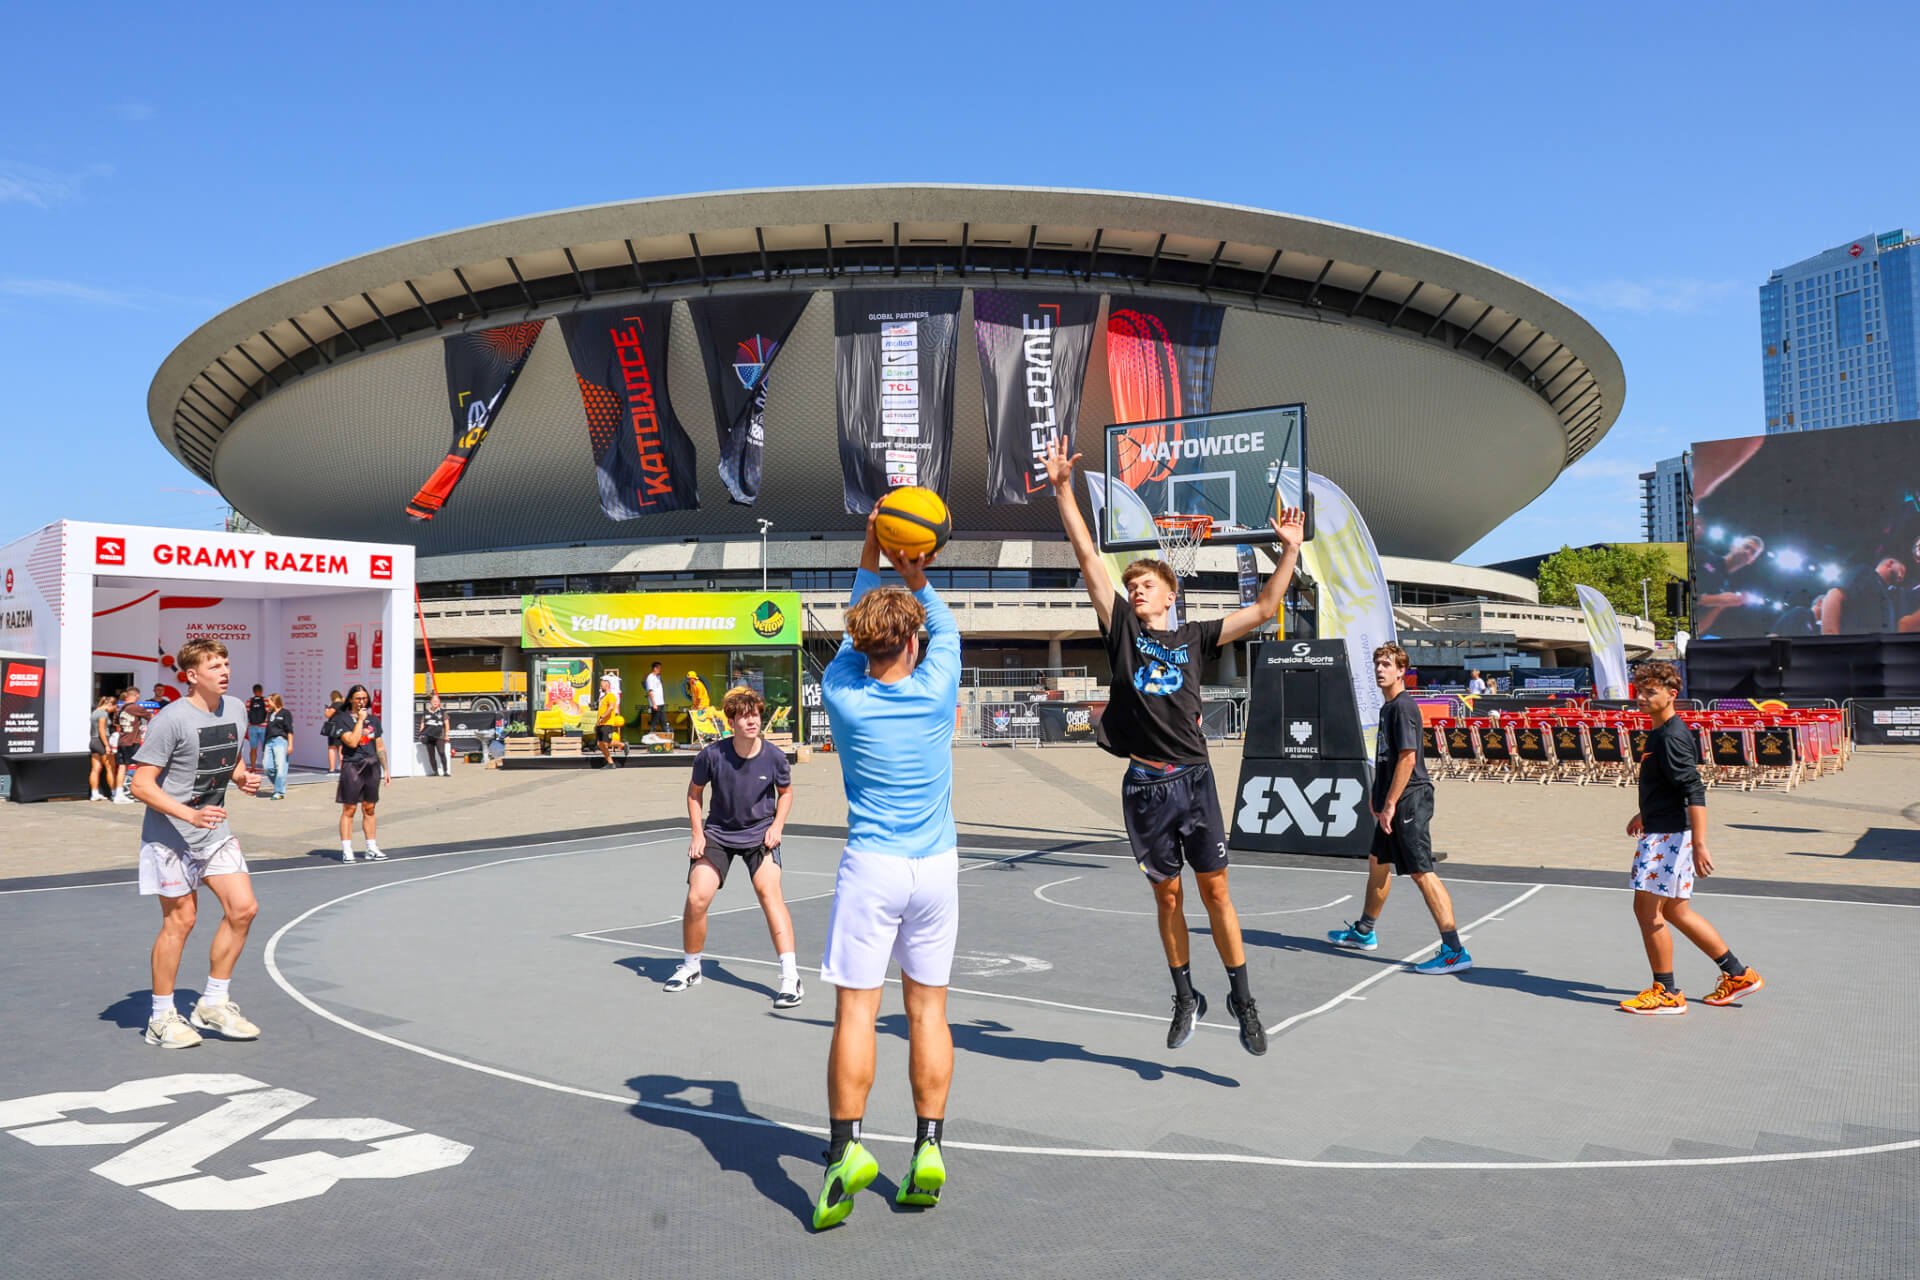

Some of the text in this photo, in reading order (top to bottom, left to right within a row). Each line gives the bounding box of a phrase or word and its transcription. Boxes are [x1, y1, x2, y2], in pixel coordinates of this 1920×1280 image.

[895, 311, 929, 320] PARTNERS
[609, 326, 673, 496] KATOWICE
[1140, 432, 1265, 463] KATOWICE
[890, 475, 915, 485] KFC
[153, 544, 349, 575] GRAMY RAZEM
[6, 610, 33, 629] RAZEM
[186, 623, 247, 632] JAK WYSOKO
[570, 614, 737, 632] Yellow Bananas
[186, 632, 252, 641] DOSKOCZYSZ?
[1304, 656, 1334, 664] Sports
[1217, 842, 1226, 858] 3
